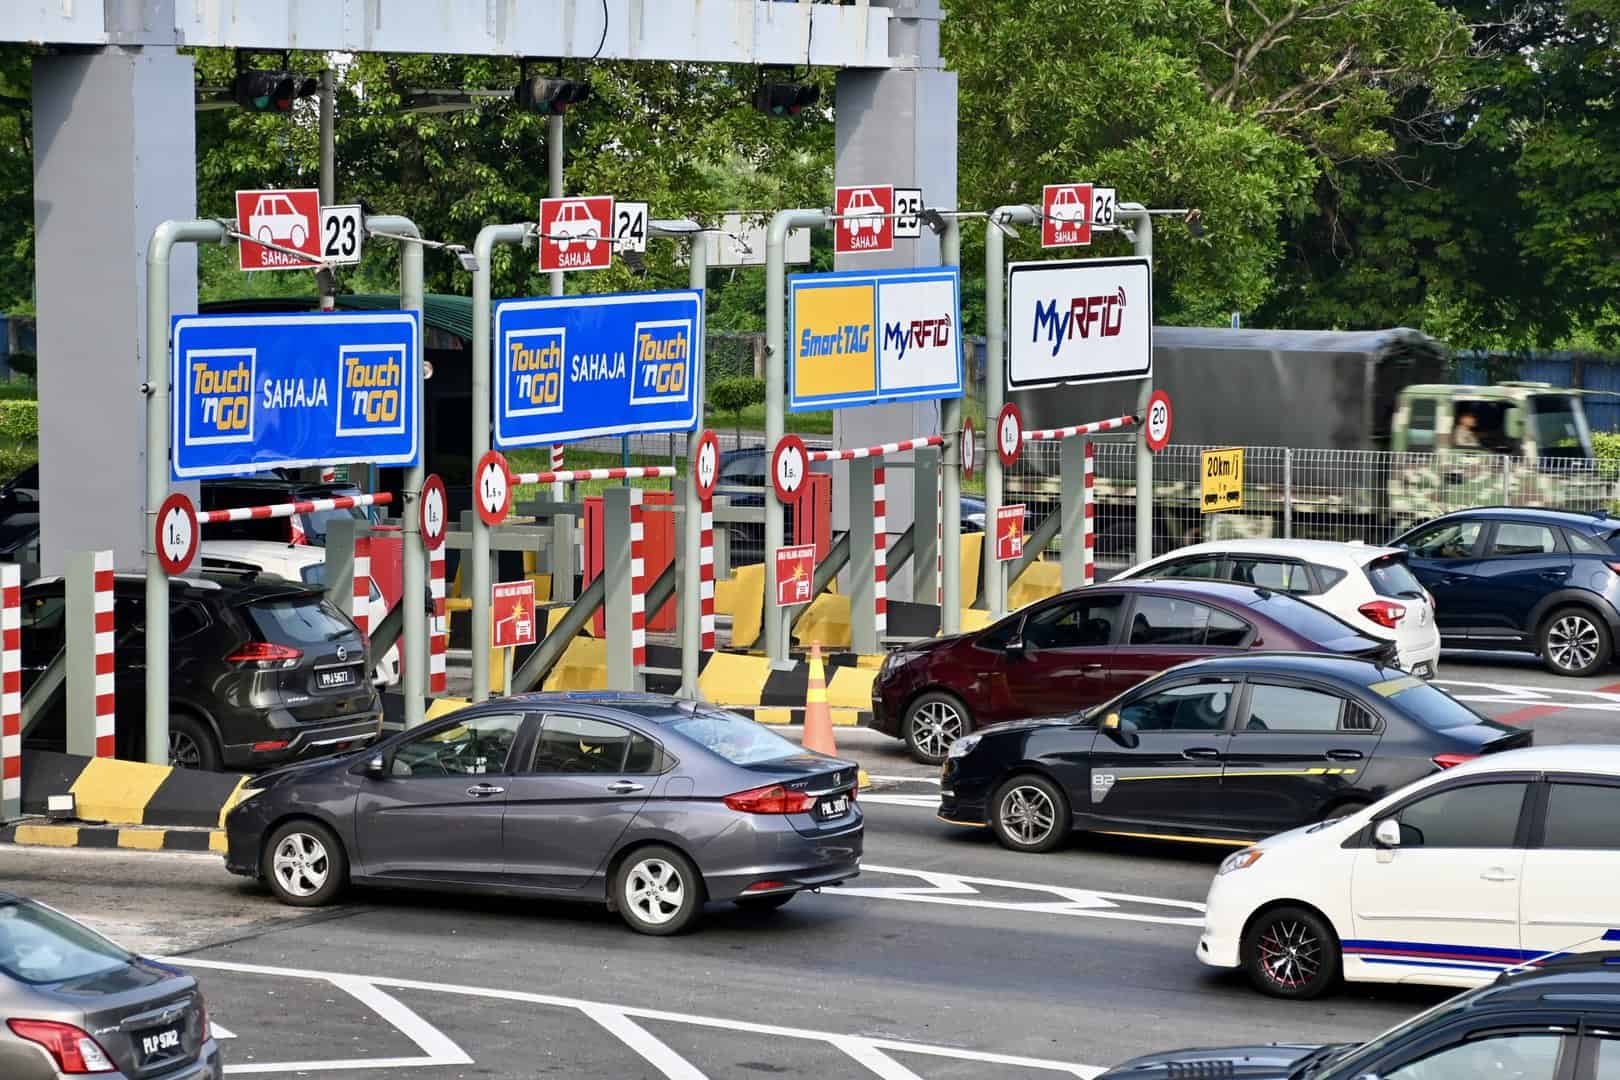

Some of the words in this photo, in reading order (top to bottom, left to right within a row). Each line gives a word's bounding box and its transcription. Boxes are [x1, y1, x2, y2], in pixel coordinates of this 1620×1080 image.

[897, 198, 918, 229] 25
[1095, 195, 1112, 224] 26
[325, 215, 357, 256] 23
[619, 211, 645, 244] 24
[850, 235, 878, 249] SAHAJA
[1054, 231, 1078, 243] SAHAJA
[558, 252, 592, 267] SAHAJA
[511, 341, 561, 372] Touch
[639, 331, 687, 361] Touch
[192, 361, 250, 394] Touch
[345, 356, 400, 389] Touch
[570, 352, 626, 383] SAHAJA
[263, 377, 328, 410] SAHAJA
[1152, 406, 1165, 425] 20
[1207, 454, 1239, 480] 20km/j
